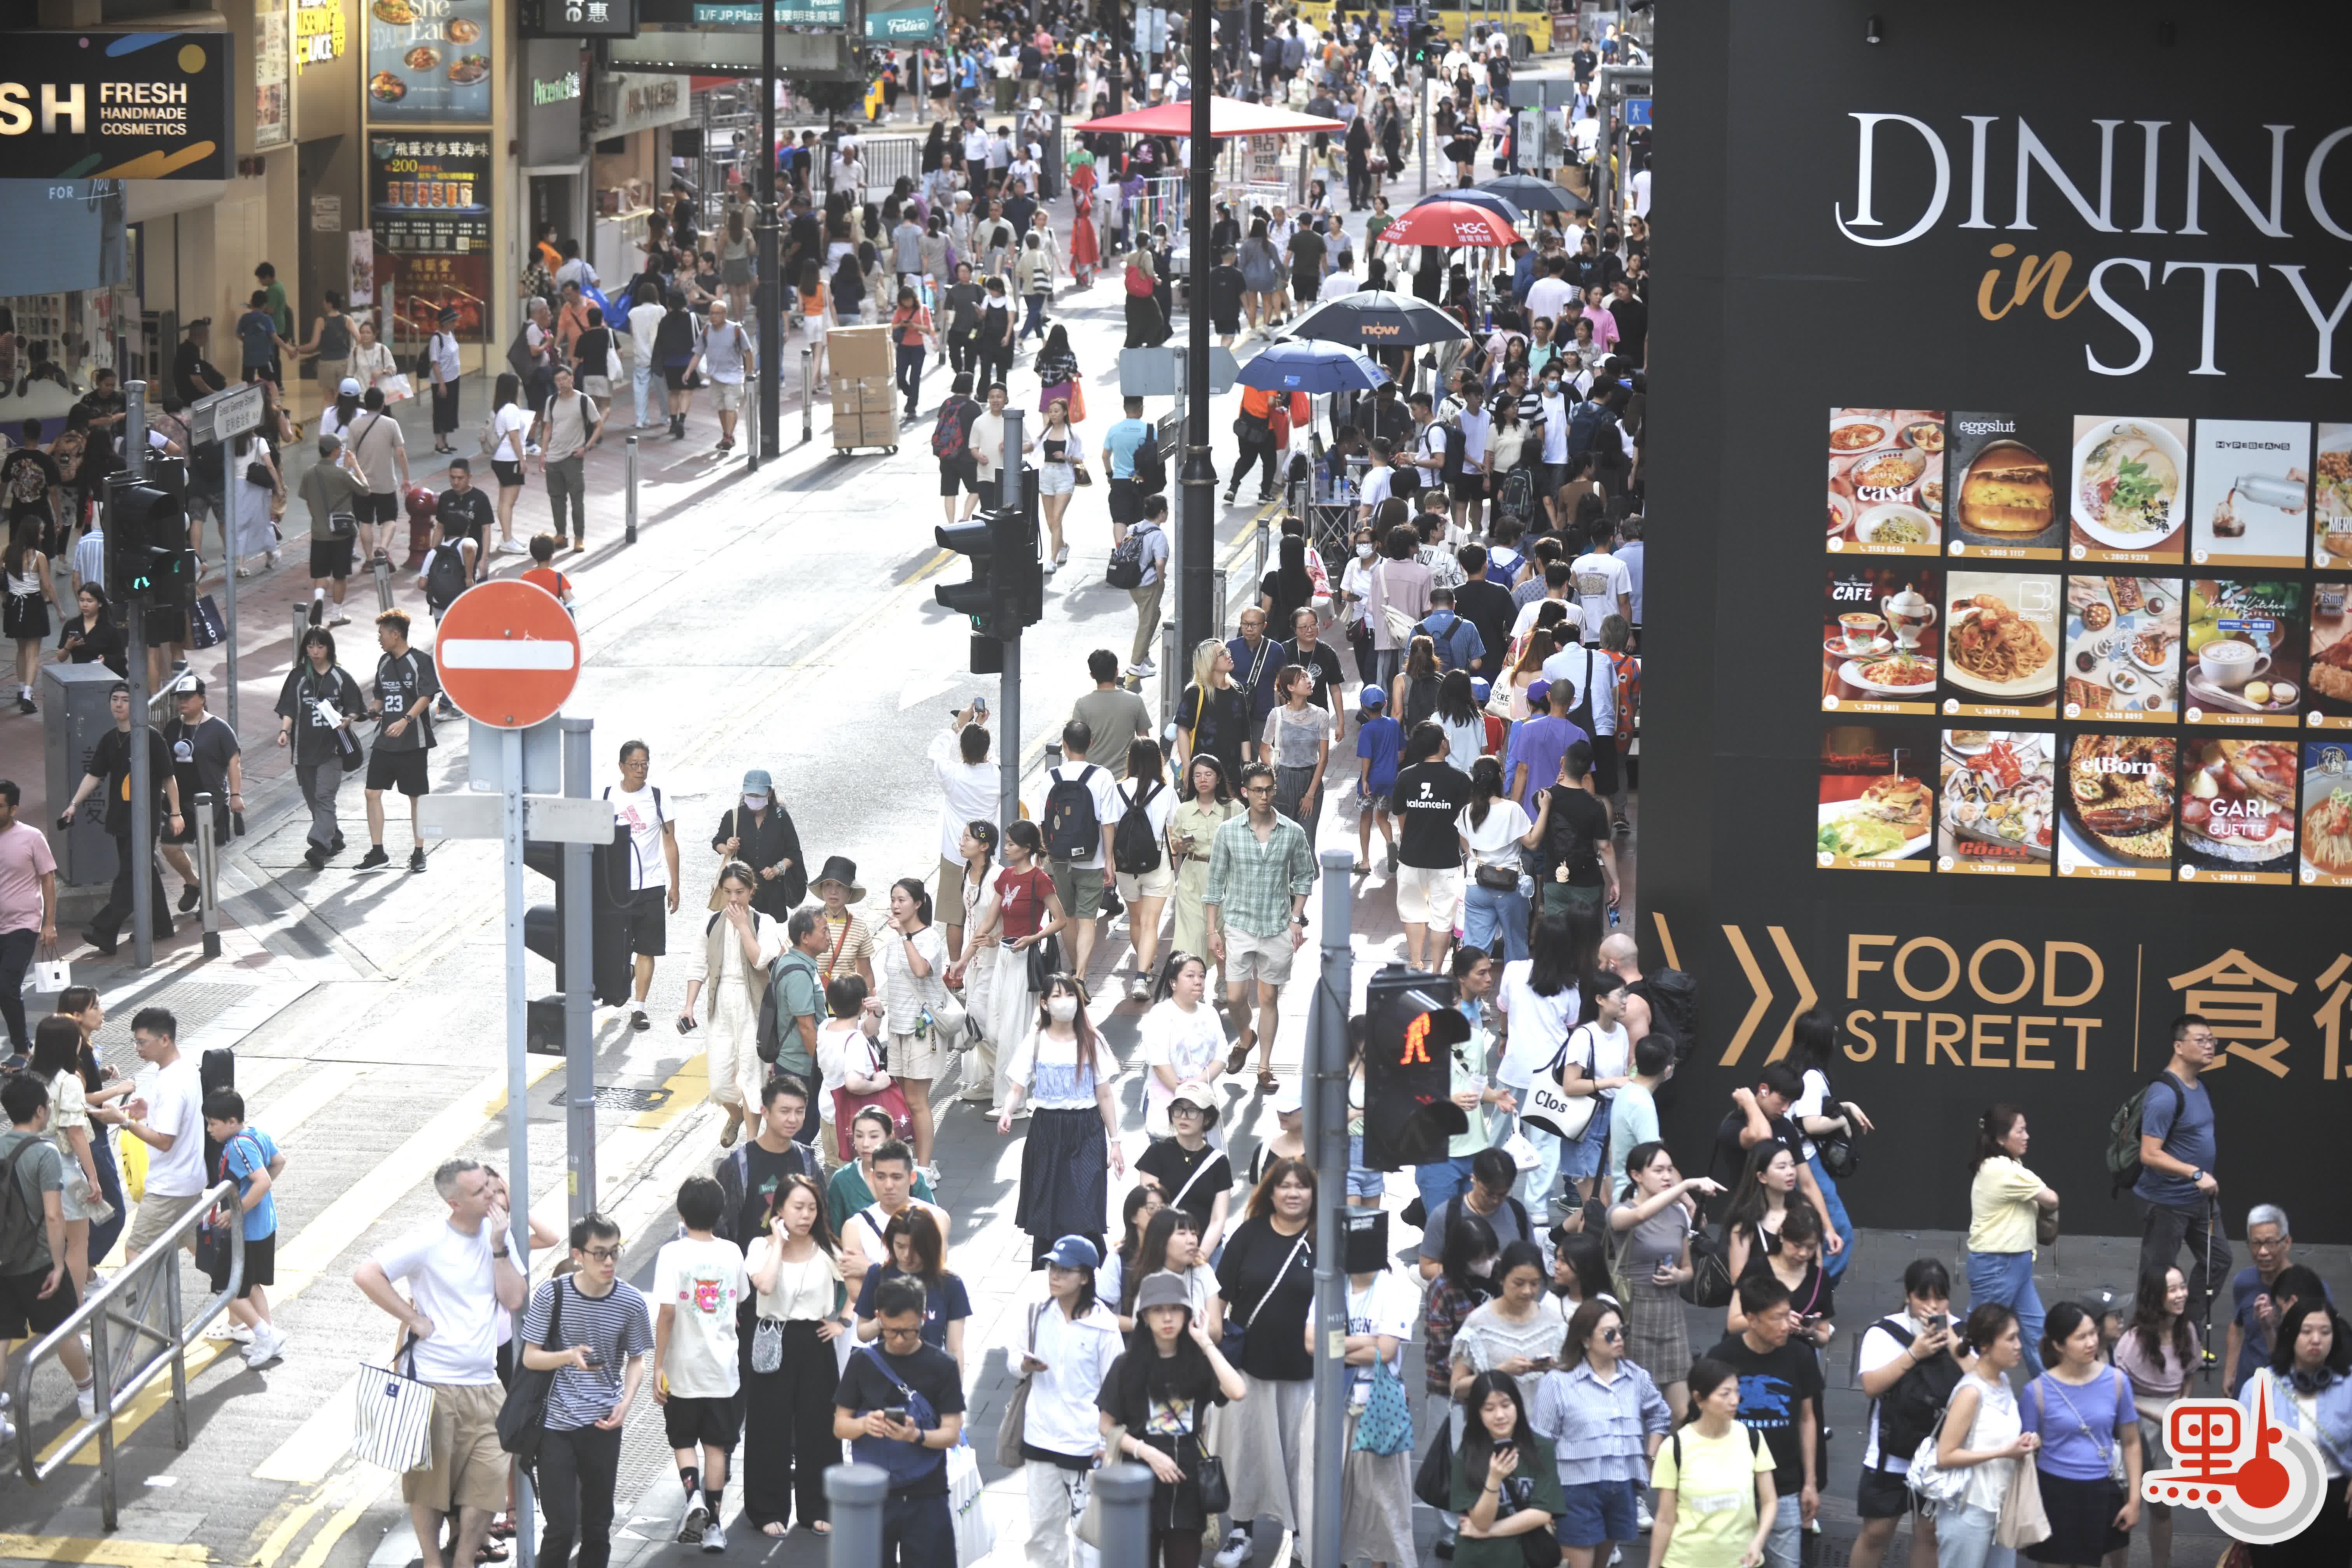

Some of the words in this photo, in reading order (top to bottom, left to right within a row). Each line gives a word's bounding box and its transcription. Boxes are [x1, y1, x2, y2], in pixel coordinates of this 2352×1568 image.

[700, 10, 716, 20] 1/F
[719, 10, 733, 20] JP
[100, 82, 187, 104] FRESH
[100, 107, 187, 120] HANDMADE
[101, 122, 187, 136] COSMETICS
[392, 159, 418, 172] 200
[49, 186, 74, 200] FOR
[1453, 222, 1489, 234] HGC
[1977, 243, 2091, 321] in
[1362, 324, 1400, 337] now
[1959, 420, 2016, 435] eggslut
[2216, 441, 2290, 450] HYPEBEANS
[1856, 485, 1914, 502] casa
[2206, 596, 2245, 618] Happy
[2244, 596, 2287, 610] Kitchen
[385, 695, 403, 712] 23
[2068, 707, 2078, 715] 25
[2189, 711, 2199, 719] 26
[2310, 714, 2321, 723] 22
[2081, 757, 2157, 775] elBorn
[2209, 798, 2267, 818] GARI
[2208, 823, 2266, 836] GUETTE
[2063, 863, 2072, 872] 15
[2303, 872, 2313, 880] 21
[1846, 934, 2104, 1007] FOOD
[1843, 1009, 2103, 1071] STREET
[1535, 1090, 1567, 1113] Clos
